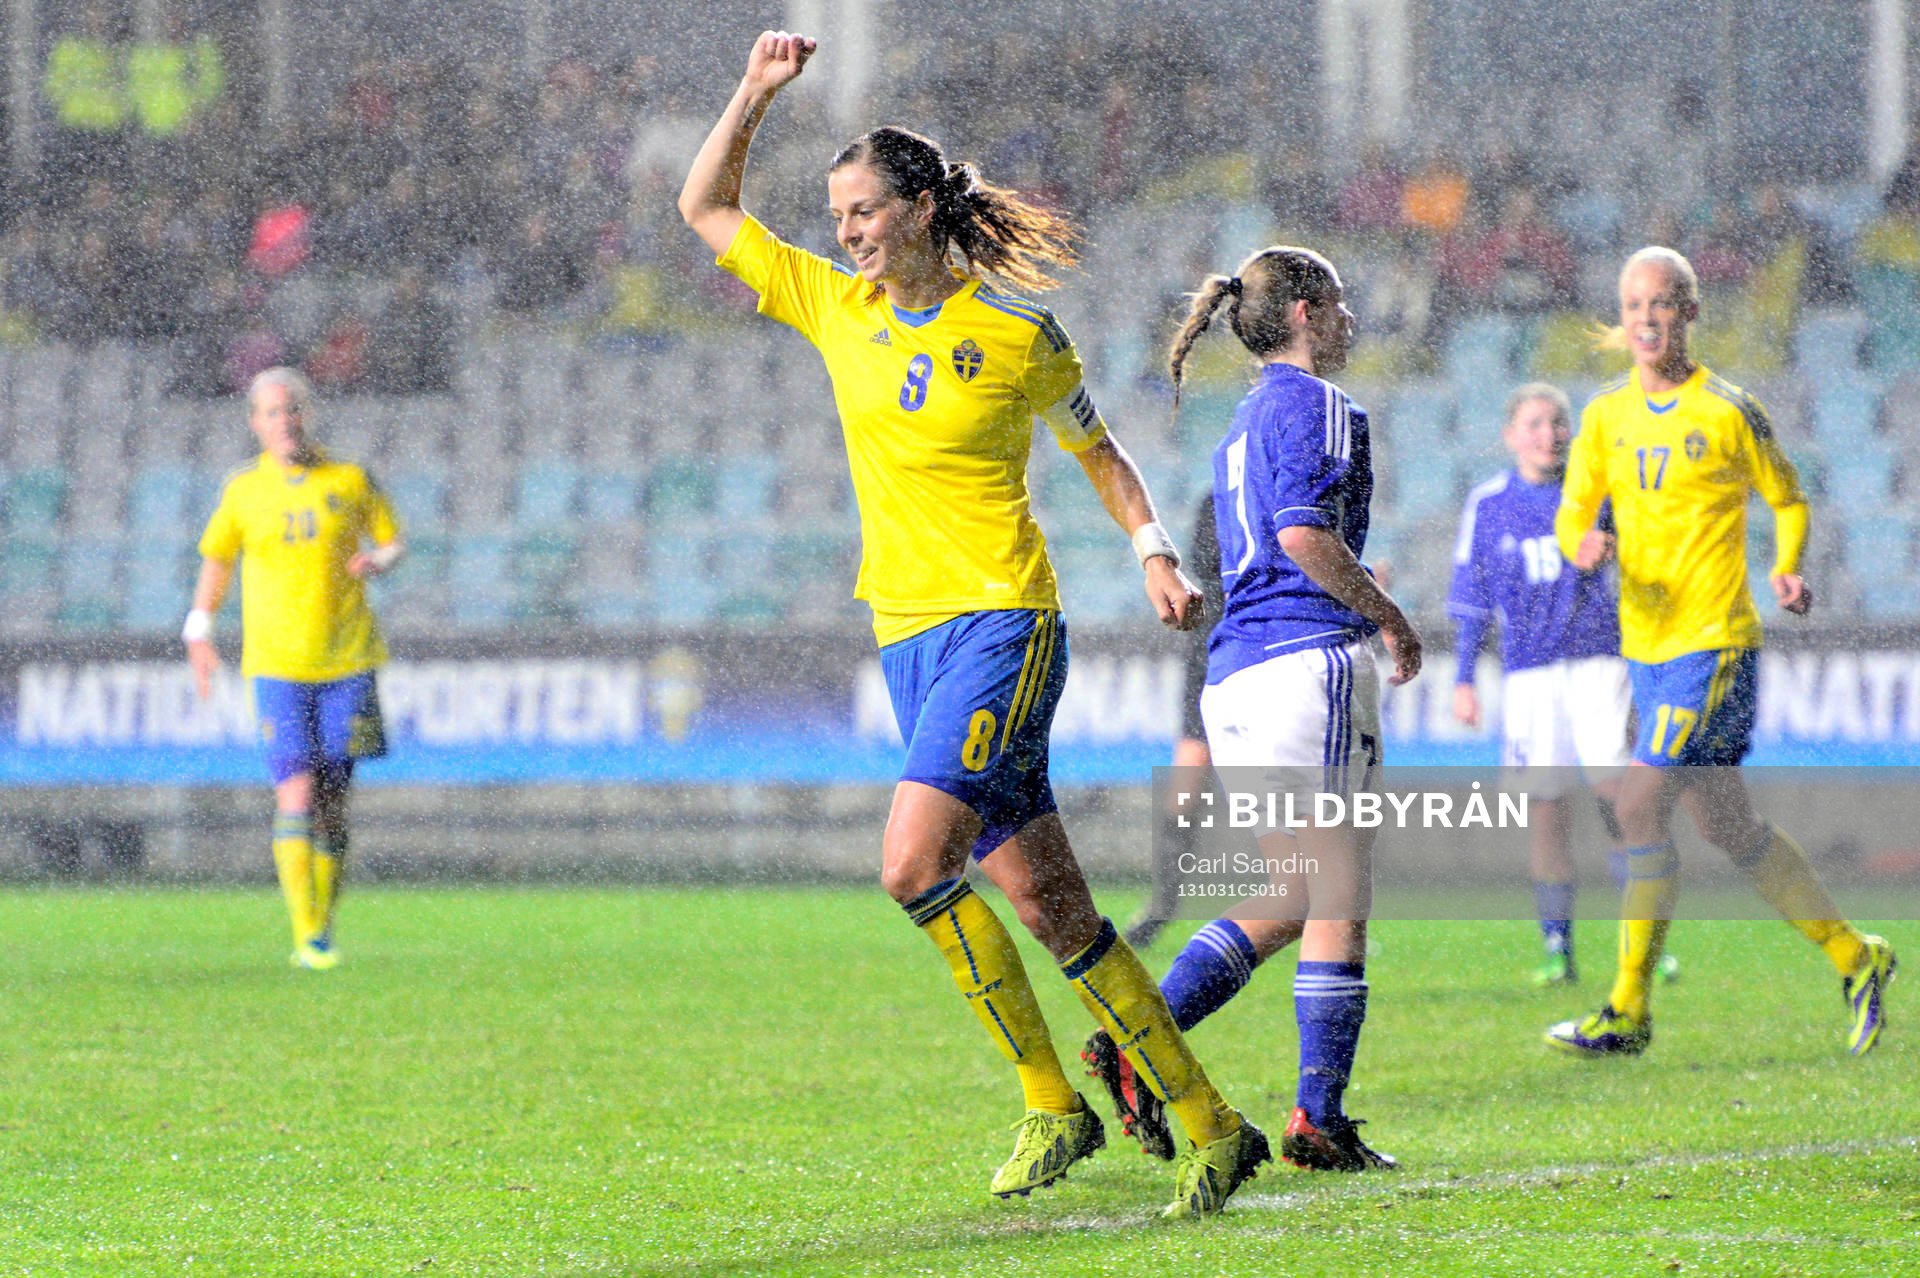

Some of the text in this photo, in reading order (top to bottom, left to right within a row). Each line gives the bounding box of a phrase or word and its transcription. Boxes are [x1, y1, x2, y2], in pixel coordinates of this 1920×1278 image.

[869, 337, 892, 347] adidas
[899, 353, 933, 412] 8
[1636, 447, 1670, 490] 17
[282, 510, 317, 543] 20
[961, 709, 996, 772] 8
[1652, 703, 1698, 758] 17
